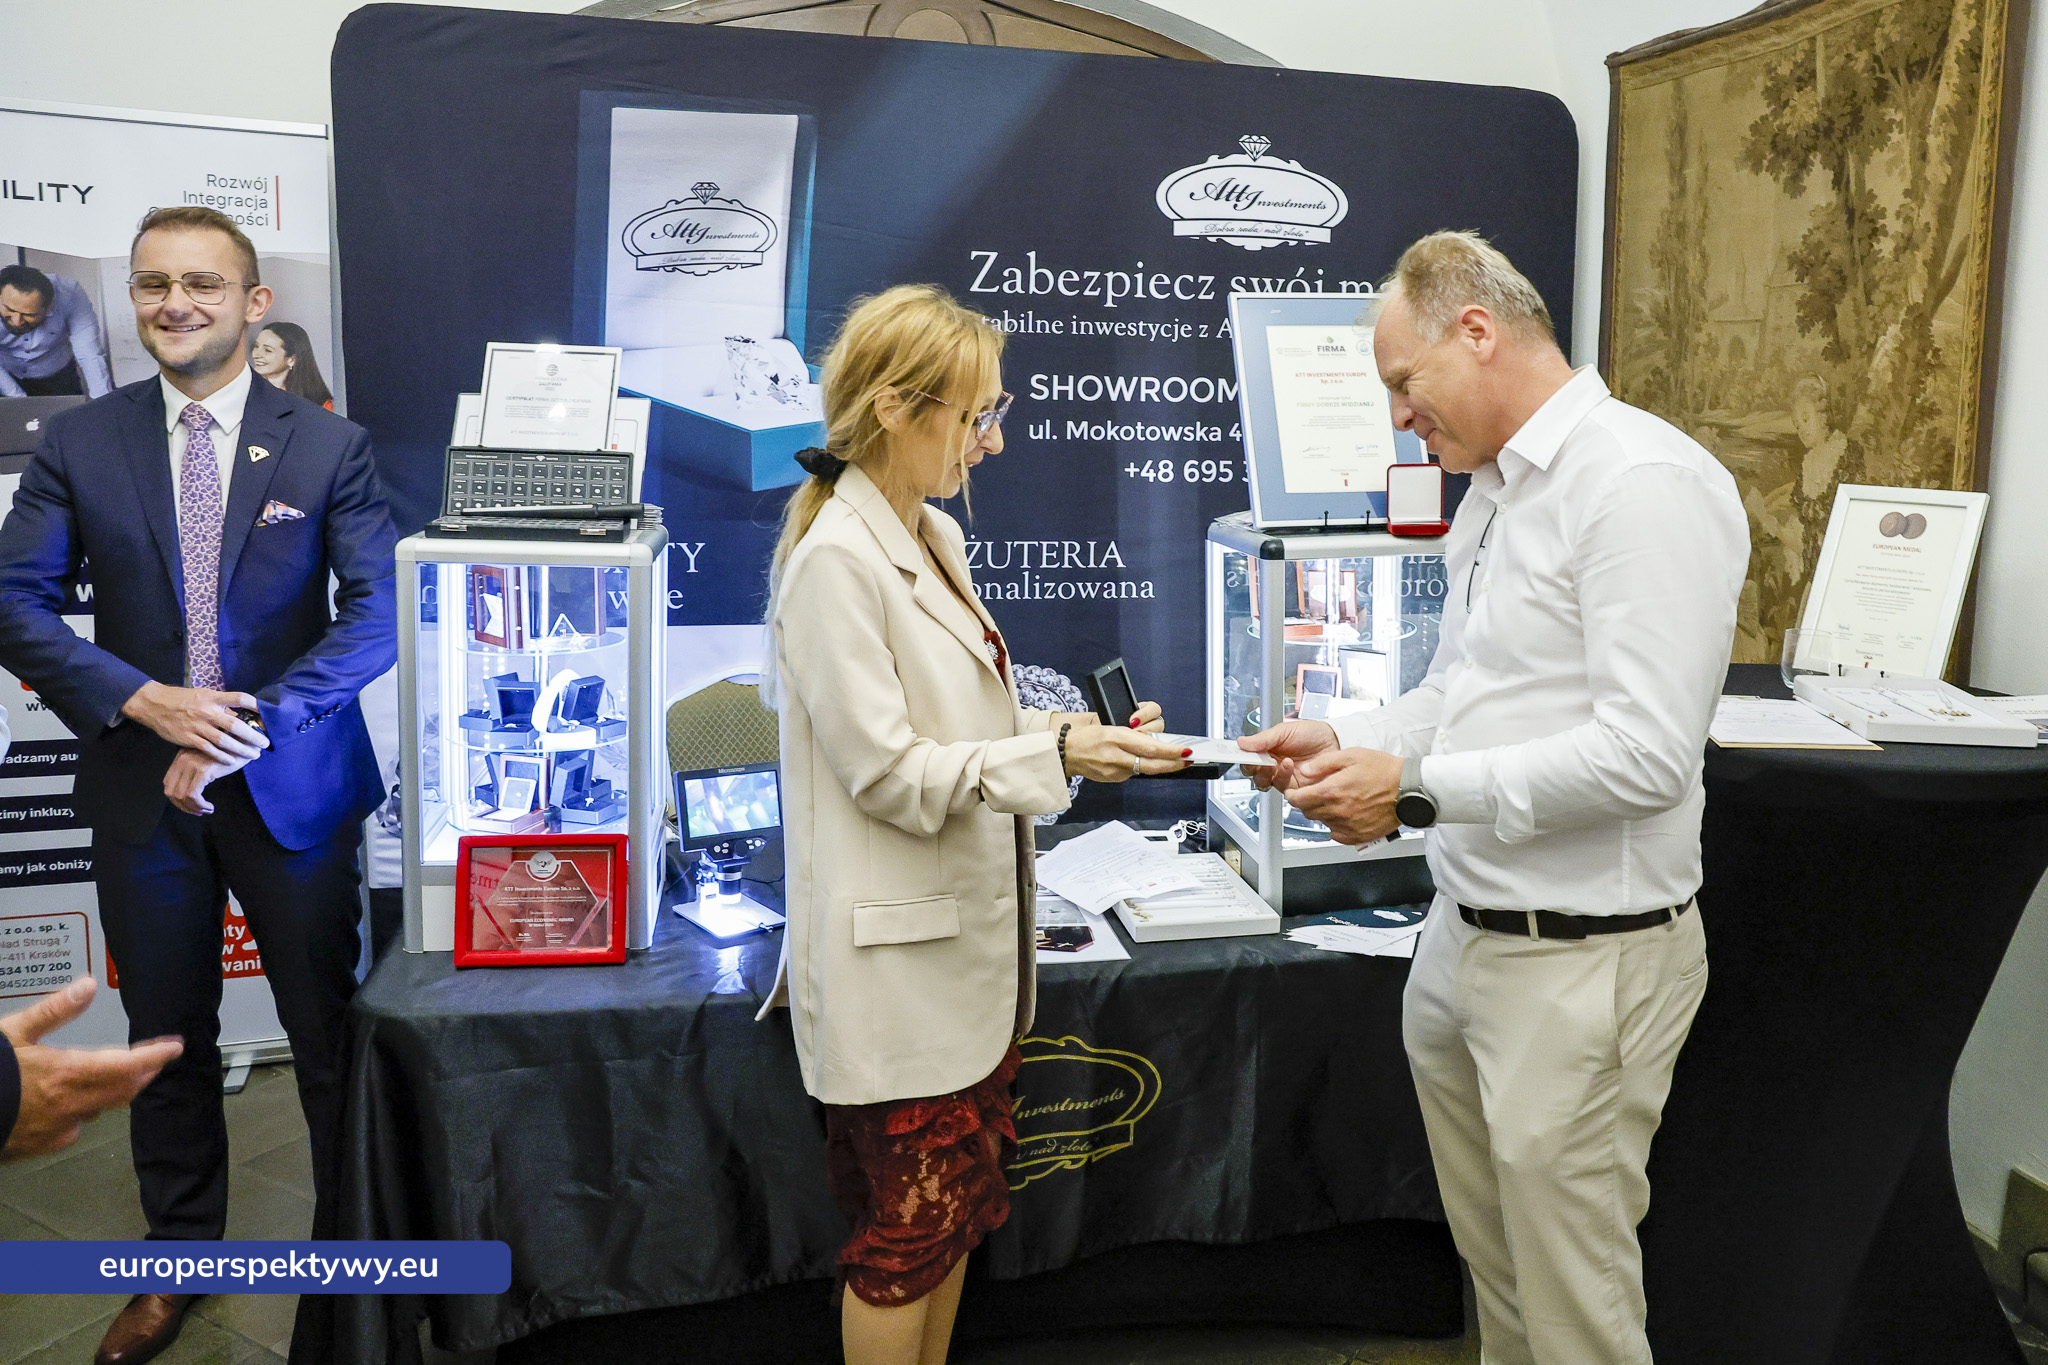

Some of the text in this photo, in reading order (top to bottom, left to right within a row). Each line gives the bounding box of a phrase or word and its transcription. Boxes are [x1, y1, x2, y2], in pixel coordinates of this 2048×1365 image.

[206, 173, 268, 194] Rozwój
[183, 190, 268, 211] Integracja
[969, 250, 1216, 307] Zabezpiecz
[1071, 315, 1192, 343] inwestycje
[1198, 324, 1209, 338] z
[1029, 374, 1238, 403] SHOWROOM
[1028, 420, 1058, 441] ul.
[1066, 420, 1222, 442] Mokotowska
[1124, 459, 1175, 483] +48
[1183, 459, 1234, 483] 695
[27, 862, 46, 875] jak
[49, 859, 93, 871] obniży
[39, 924, 57, 933] sp.
[63, 935, 70, 943] 7
[29, 949, 71, 960] Kraków
[25, 964, 45, 973] 107
[48, 961, 72, 972] 200
